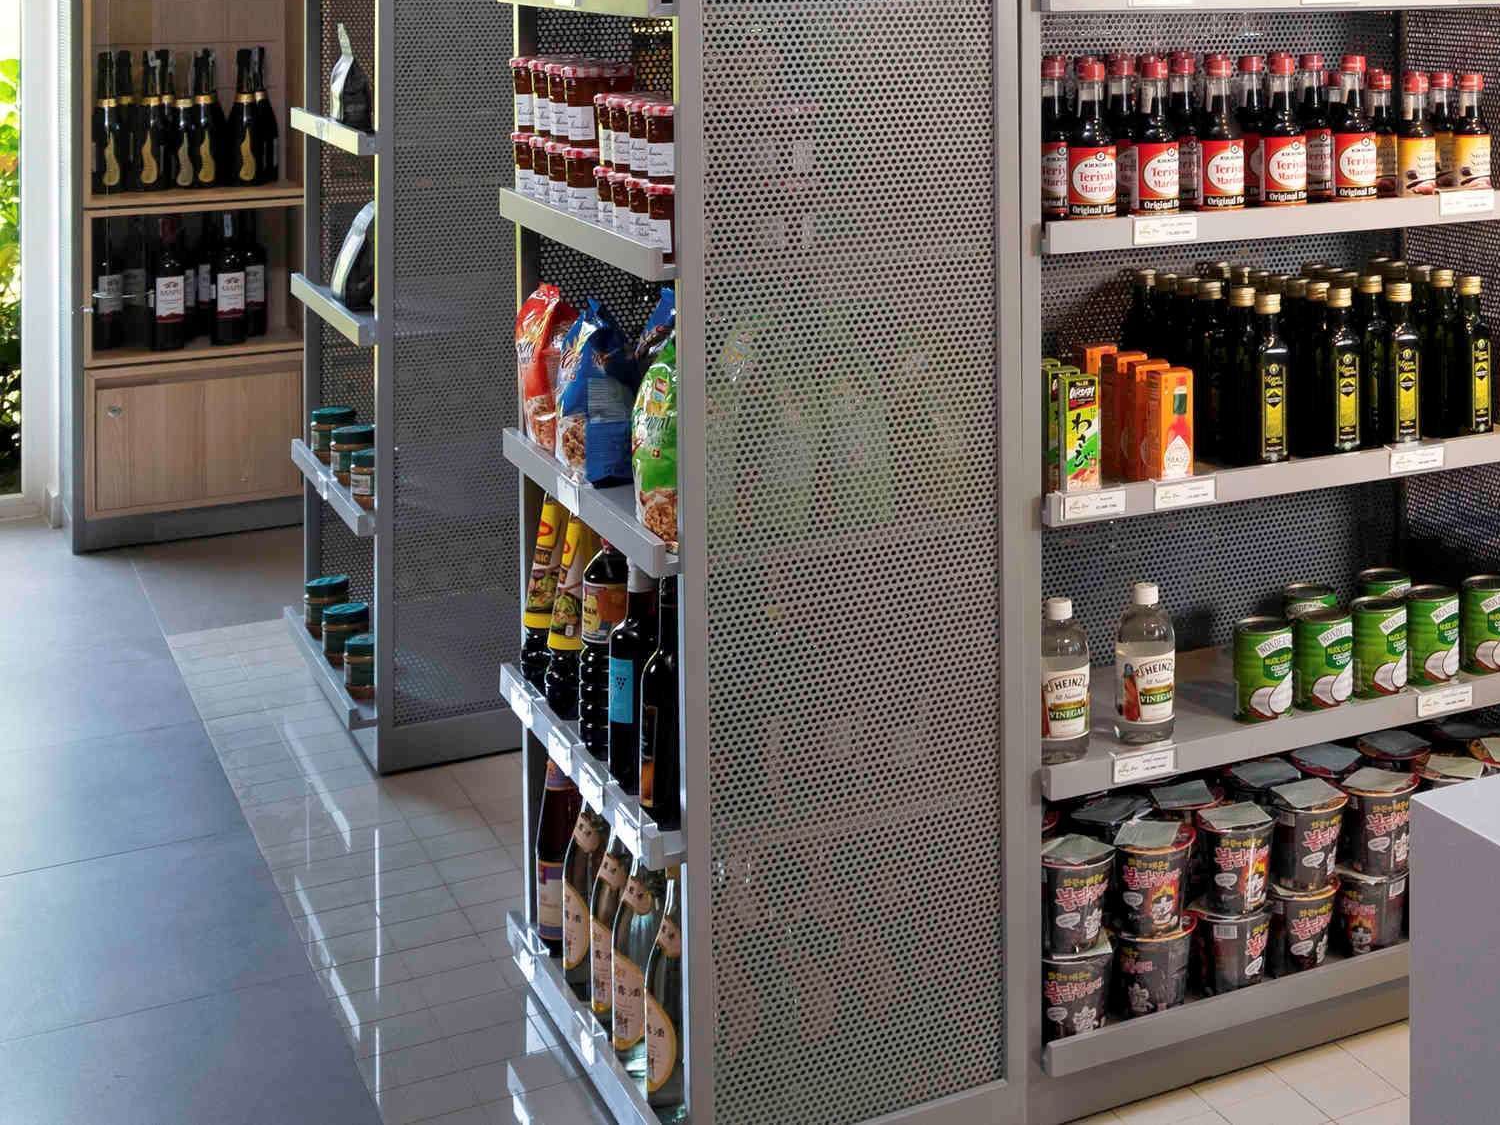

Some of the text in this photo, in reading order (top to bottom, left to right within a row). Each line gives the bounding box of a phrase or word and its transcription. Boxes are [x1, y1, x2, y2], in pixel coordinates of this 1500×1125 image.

[1269, 191, 1297, 202] Original
[1340, 187, 1367, 197] Original
[1144, 200, 1171, 211] Original
[1207, 196, 1235, 207] Original
[1072, 204, 1101, 216] Original
[1145, 662, 1175, 676] HEINZ
[1055, 676, 1083, 691] HEINZ
